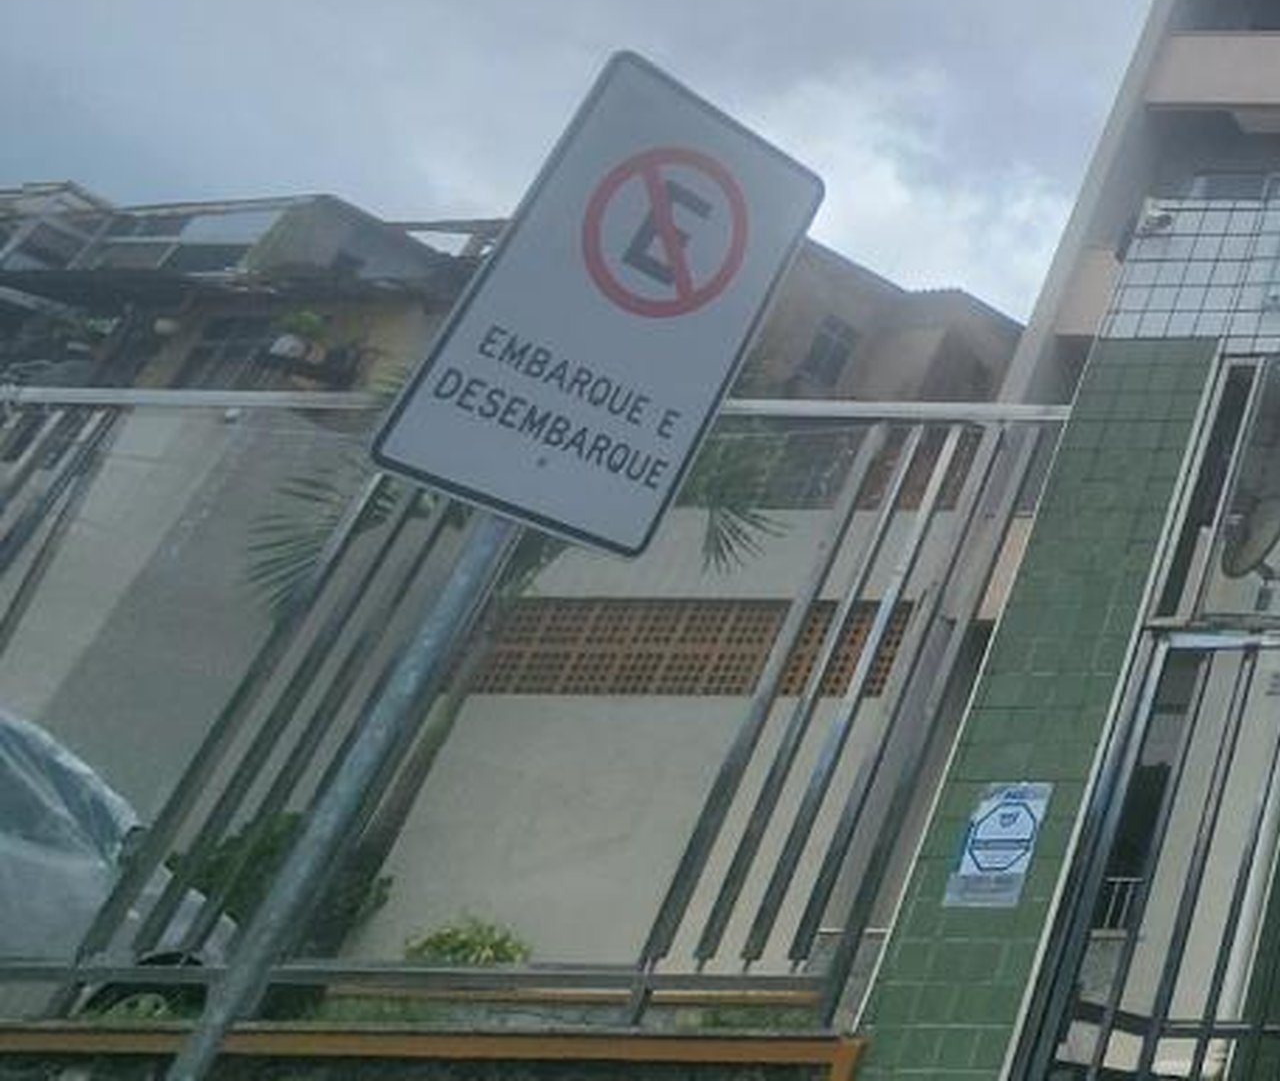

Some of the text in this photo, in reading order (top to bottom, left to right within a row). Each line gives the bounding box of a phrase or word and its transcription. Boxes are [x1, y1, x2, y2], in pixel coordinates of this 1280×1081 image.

[432, 367, 670, 491] DESEMBARQUE
[478, 325, 683, 441] EMBARQUE E
